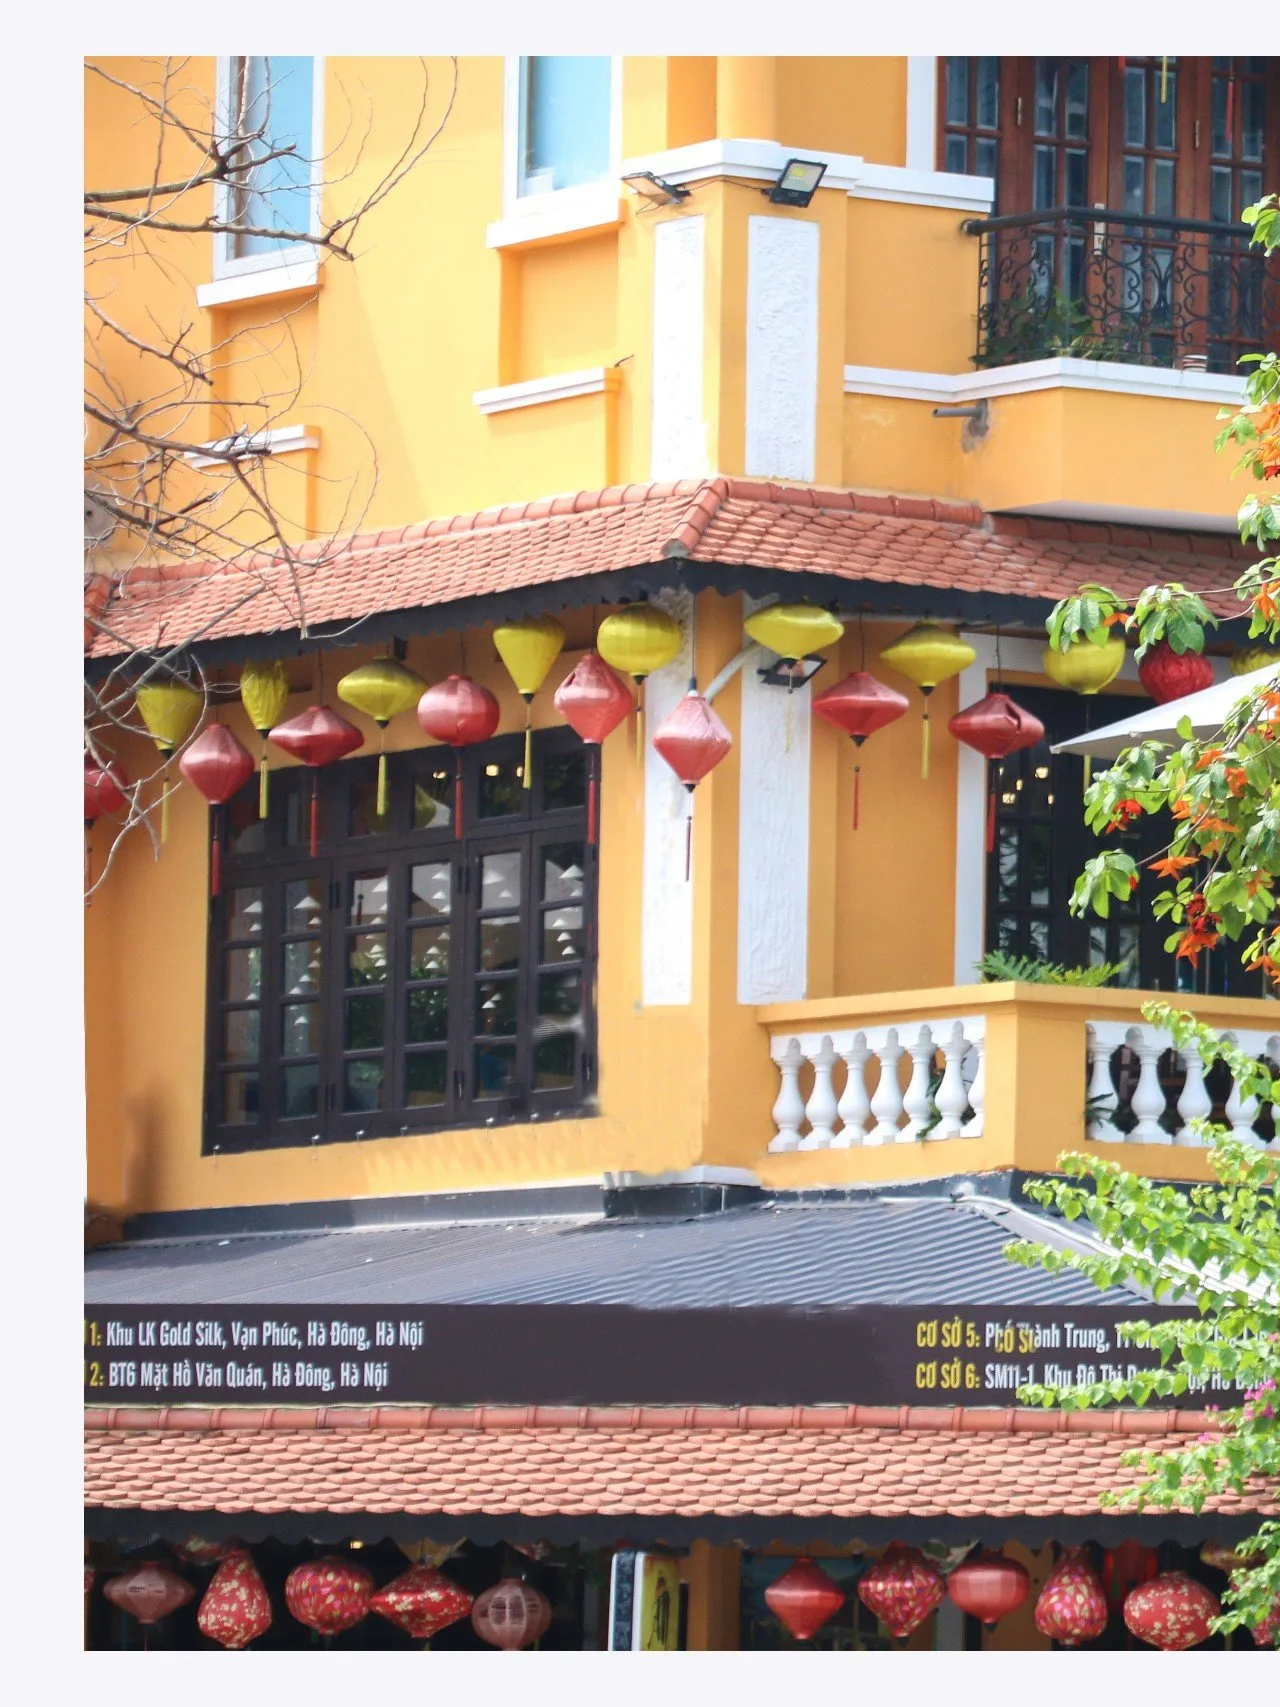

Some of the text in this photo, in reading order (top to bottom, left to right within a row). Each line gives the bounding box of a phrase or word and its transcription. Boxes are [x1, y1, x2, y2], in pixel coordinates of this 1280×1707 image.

[106, 1321, 133, 1346] Khu
[138, 1321, 155, 1346] LK
[160, 1321, 191, 1346] Gold
[195, 1321, 227, 1350] Silk,
[231, 1321, 257, 1350] Vạn
[262, 1321, 302, 1350] Phúc,
[307, 1321, 327, 1346] Hà
[330, 1321, 370, 1351] Đông,
[375, 1321, 395, 1346] Hà
[399, 1321, 424, 1351] Nội
[916, 1319, 938, 1348] CƠ
[941, 1315, 963, 1348] SỞ
[966, 1322, 980, 1348] 5:
[1064, 1322, 1111, 1353] Trung,
[109, 1361, 135, 1387] BT6
[140, 1361, 168, 1392] Mặt
[173, 1358, 191, 1387] Hồ
[195, 1361, 222, 1387] Văn
[226, 1361, 267, 1391] Quán,
[272, 1361, 291, 1387] Hà
[295, 1361, 335, 1392] Đông,
[340, 1361, 360, 1387] Hà
[363, 1361, 389, 1392] Nội
[916, 1360, 936, 1389] CƠ
[940, 1356, 962, 1389] SỞ
[965, 1363, 980, 1389] 6:
